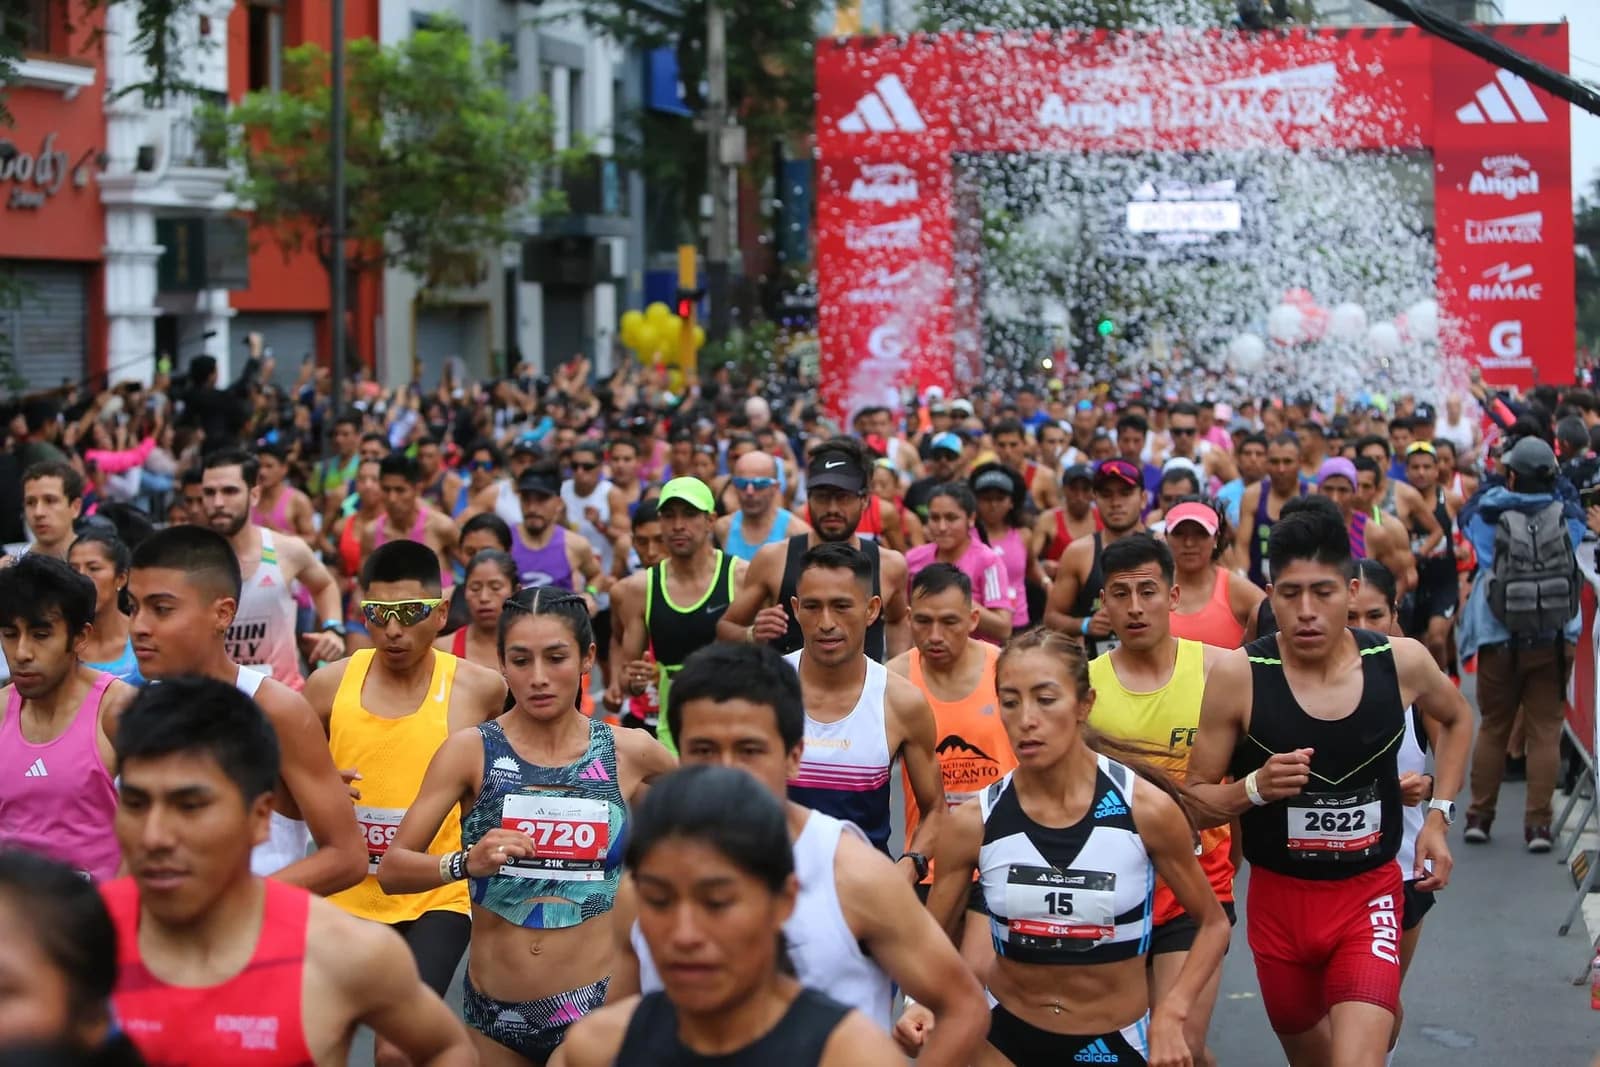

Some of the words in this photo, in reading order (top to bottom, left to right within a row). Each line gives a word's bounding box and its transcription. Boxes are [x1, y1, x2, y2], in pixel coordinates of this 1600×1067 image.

[1469, 170, 1539, 200] Angel
[1468, 283, 1542, 300] RIMAC
[942, 766, 999, 780] NCANTO
[1094, 806, 1127, 819] adidas
[1304, 809, 1366, 832] 2622
[517, 821, 595, 848] 2720
[544, 858, 564, 868] 21K
[1044, 892, 1073, 915] 15
[1047, 925, 1069, 935] 42K
[1368, 894, 1400, 966] PERÚ
[1073, 1050, 1119, 1063] adidas
